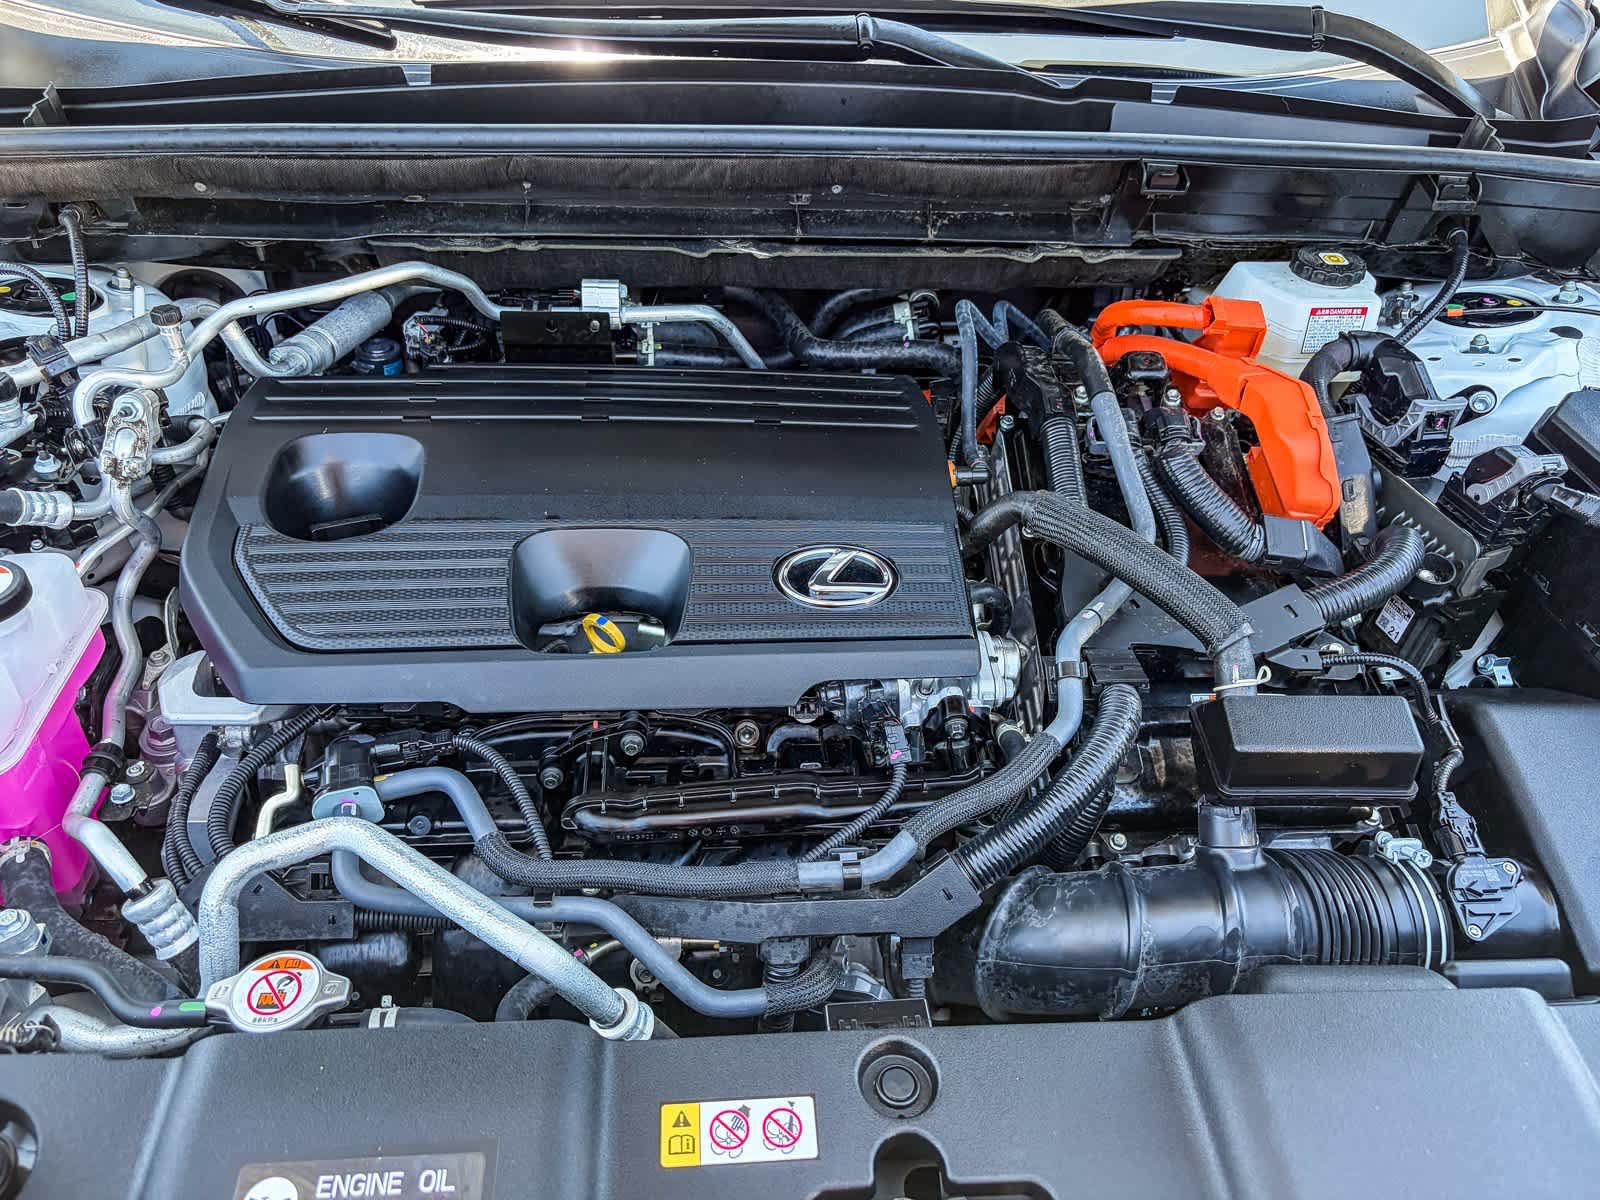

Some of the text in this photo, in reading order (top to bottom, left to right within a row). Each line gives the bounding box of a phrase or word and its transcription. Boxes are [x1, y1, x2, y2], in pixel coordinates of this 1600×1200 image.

[1387, 625, 1400, 641] 21
[315, 1169, 456, 1199] ENGINE OIL
